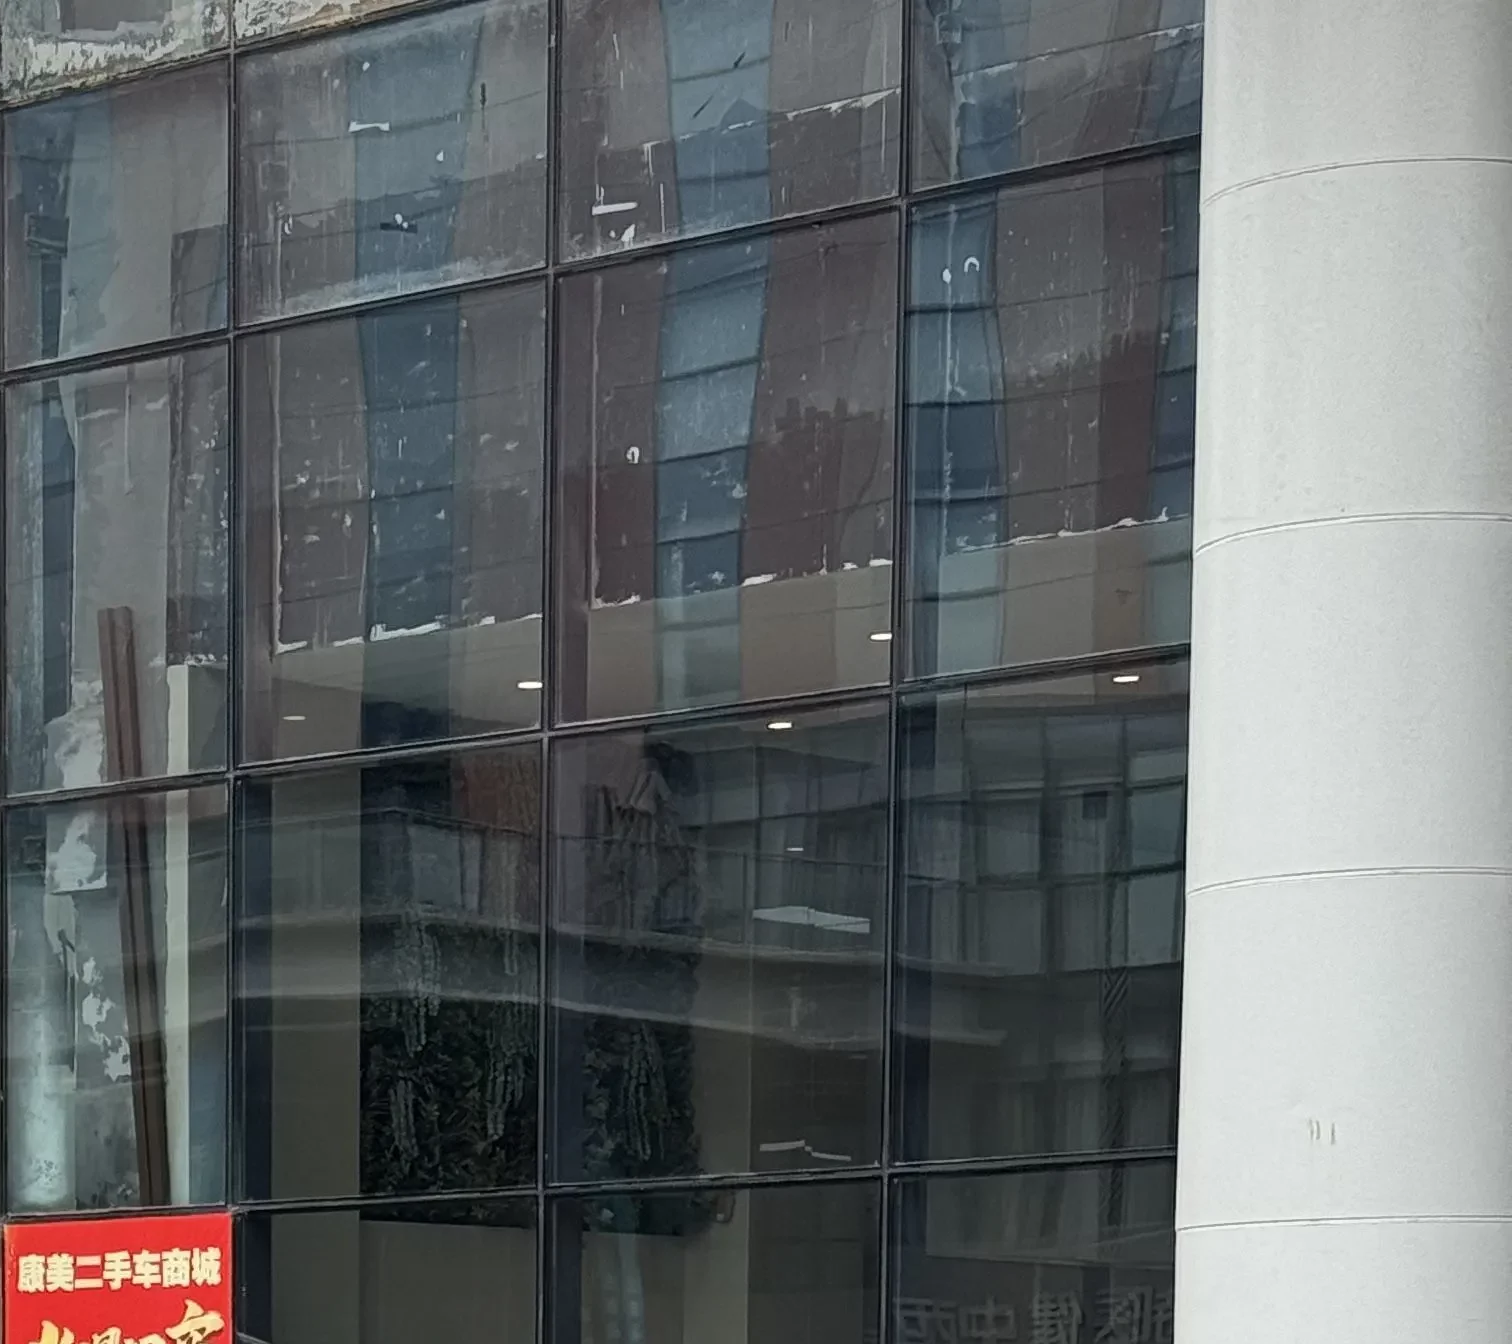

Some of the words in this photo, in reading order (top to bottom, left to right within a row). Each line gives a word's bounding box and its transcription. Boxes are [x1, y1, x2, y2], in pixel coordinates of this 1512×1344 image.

[18, 1248, 221, 1293] 康美二手车商城
